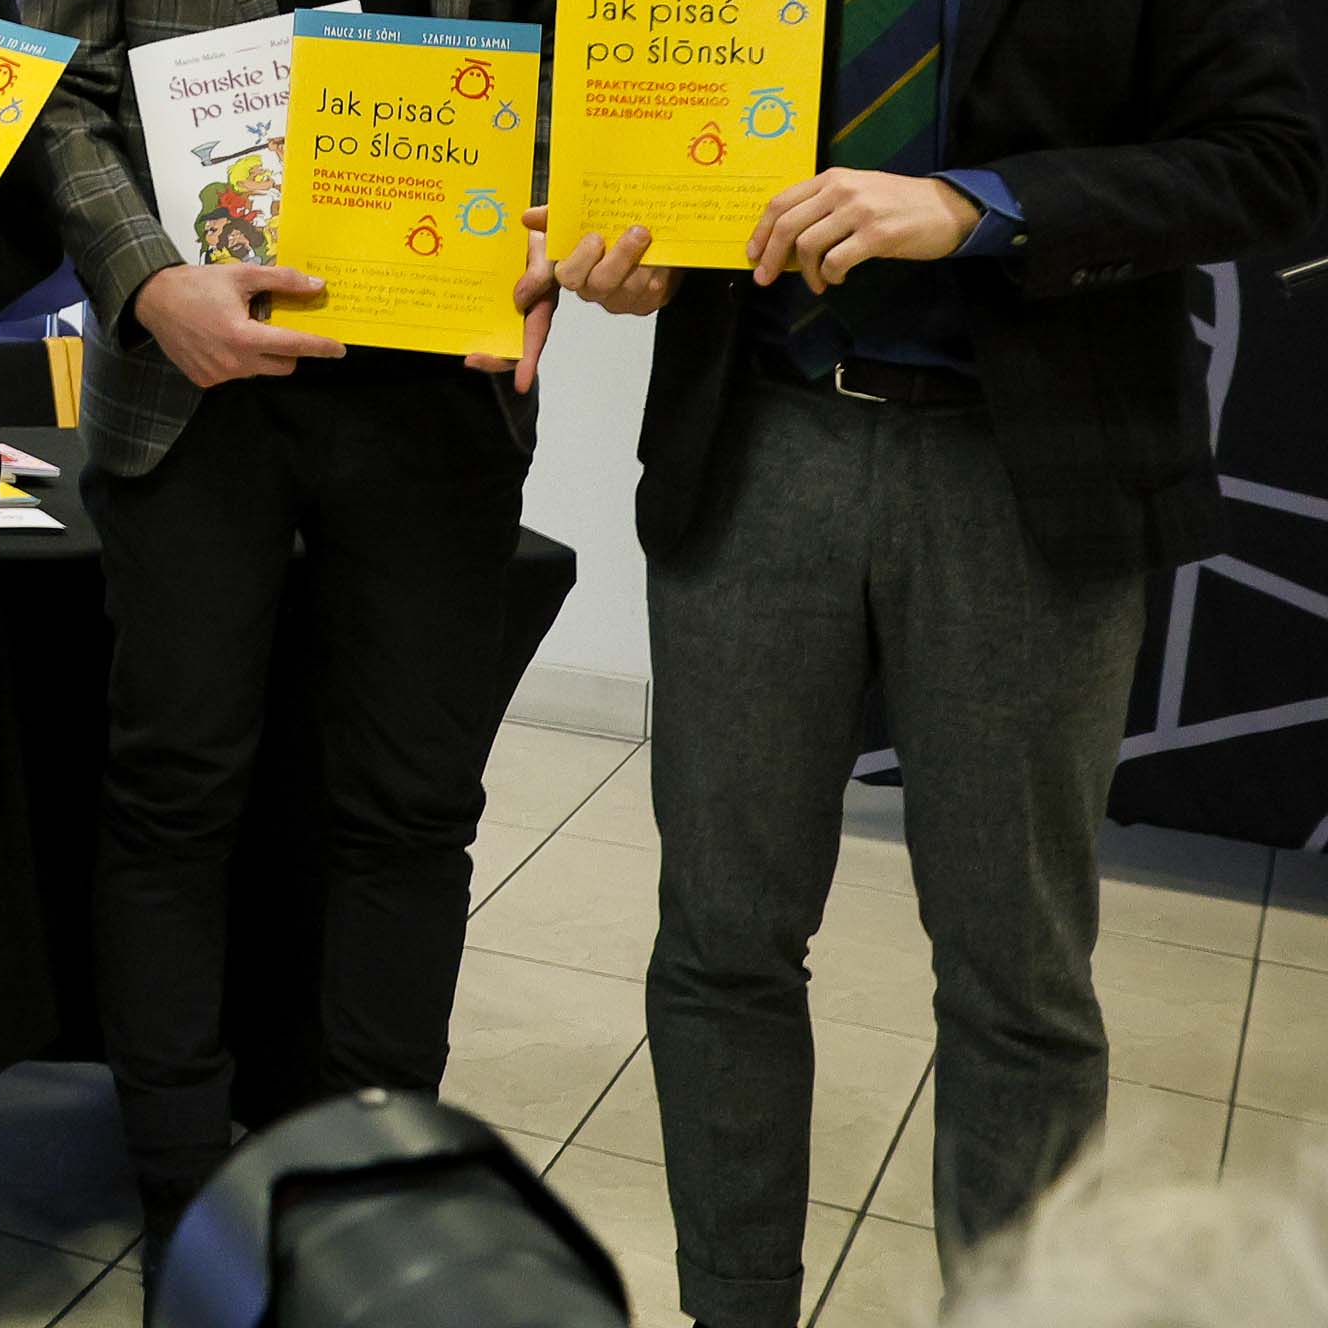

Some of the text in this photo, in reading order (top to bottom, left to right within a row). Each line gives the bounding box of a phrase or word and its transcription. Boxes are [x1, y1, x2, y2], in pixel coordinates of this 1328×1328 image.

[323, 25, 354, 38] NAUCZ
[358, 27, 372, 40] SIE
[422, 32, 461, 47] SZAFNIJ
[465, 35, 477, 47] TO
[480, 36, 511, 49] SAMA!
[586, 42, 635, 70] po
[586, 79, 675, 92] PRAKTYCZNO
[316, 88, 456, 128] Jak pisać
[586, 94, 605, 105] DO
[609, 94, 651, 105] NAUKI
[192, 106, 223, 128] po
[313, 133, 479, 166] po ślōnsku
[313, 168, 395, 186] PRAKTYCZNO
[312, 181, 331, 192] DO
[334, 183, 373, 197] NAUKI
